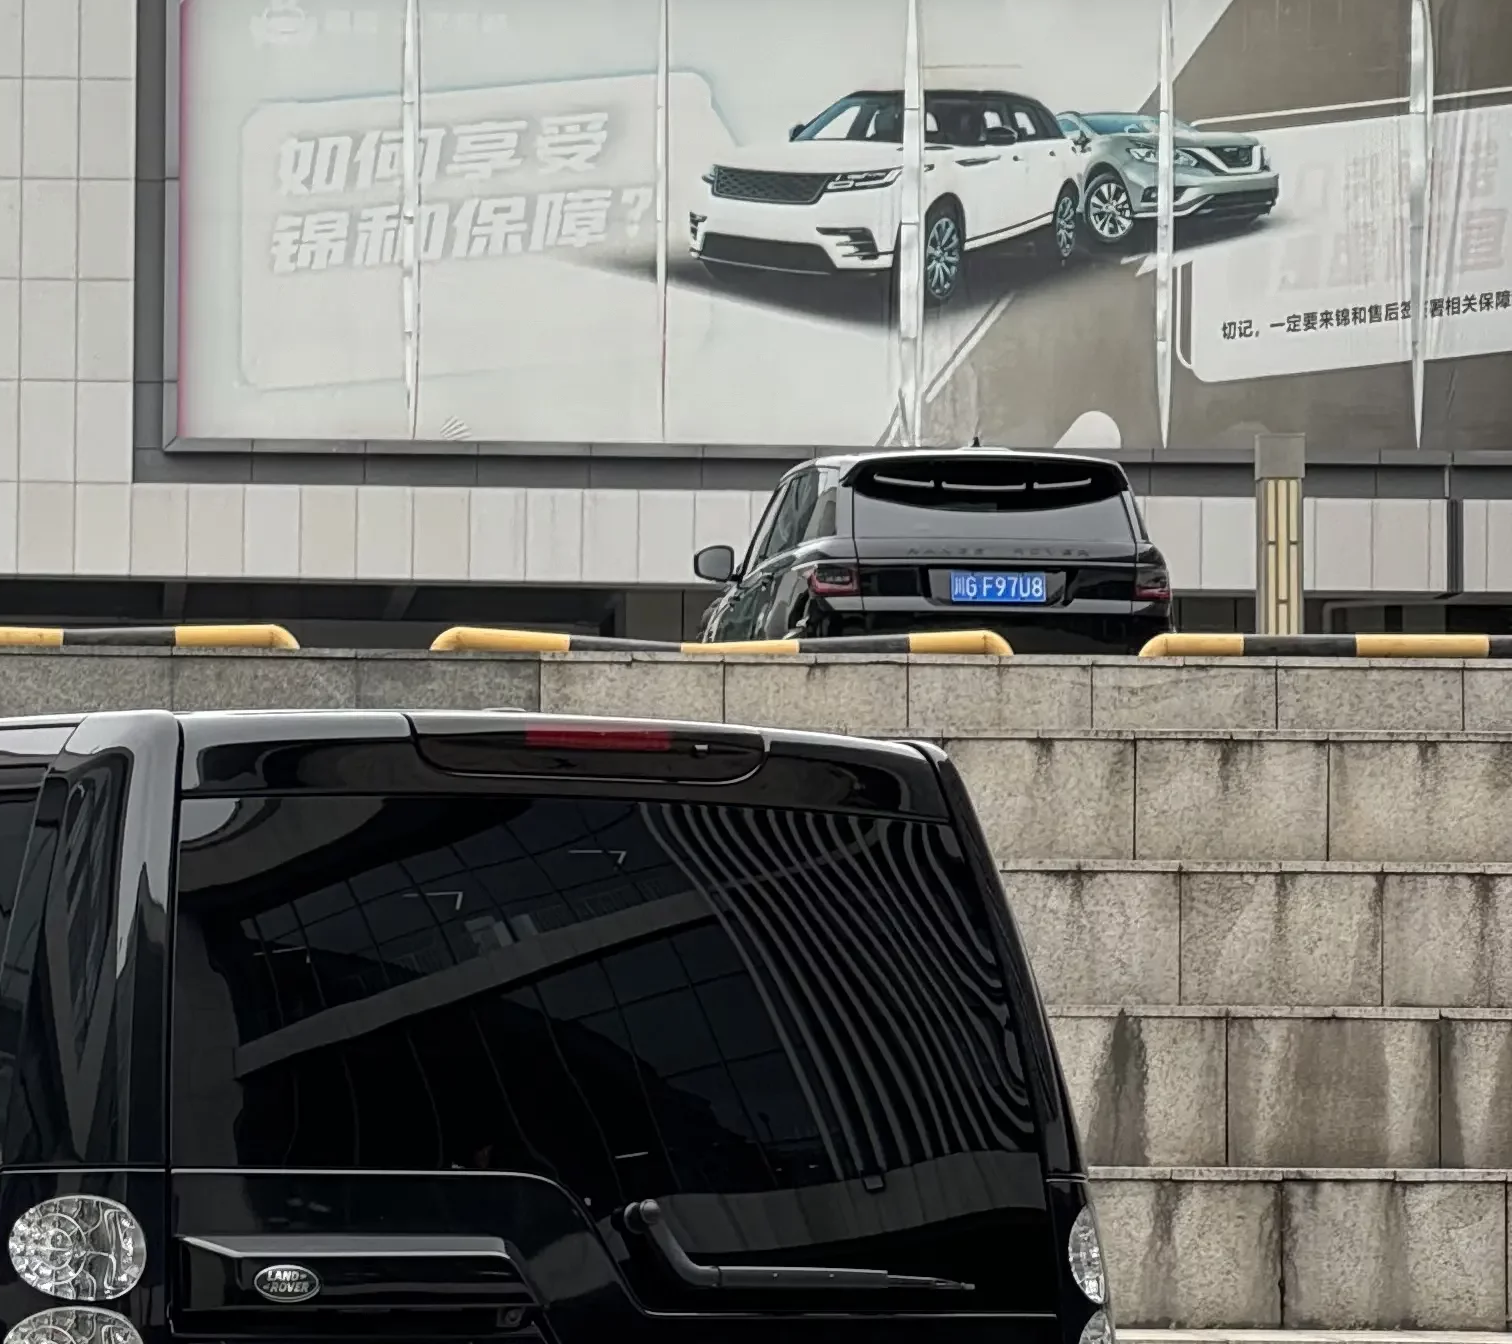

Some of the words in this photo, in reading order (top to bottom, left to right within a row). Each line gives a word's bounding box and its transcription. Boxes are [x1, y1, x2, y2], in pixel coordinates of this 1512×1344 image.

[279, 112, 609, 196] 如何享受
[271, 187, 654, 274] 锦和保障？
[266, 1270, 300, 1281] LAND
[269, 1281, 310, 1293] ROVER
